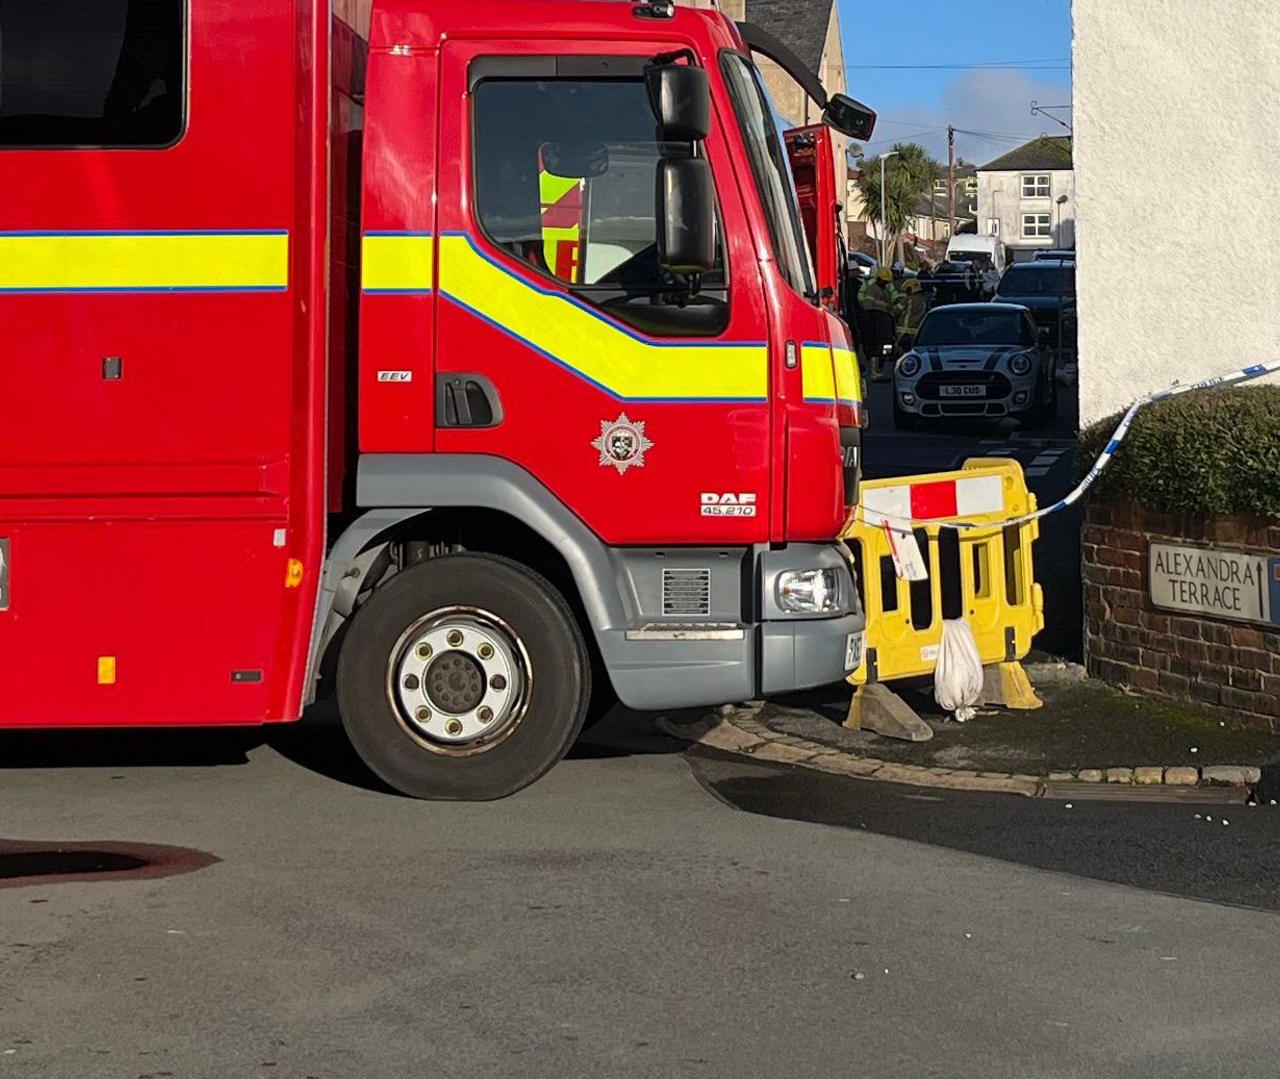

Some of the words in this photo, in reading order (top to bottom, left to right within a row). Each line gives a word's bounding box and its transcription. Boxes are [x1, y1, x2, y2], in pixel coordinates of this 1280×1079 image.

[380, 372, 409, 381] EEV
[700, 492, 757, 504] DAF
[1155, 551, 1255, 586] ALEXANDRA
[1168, 579, 1241, 611] TERRACE
